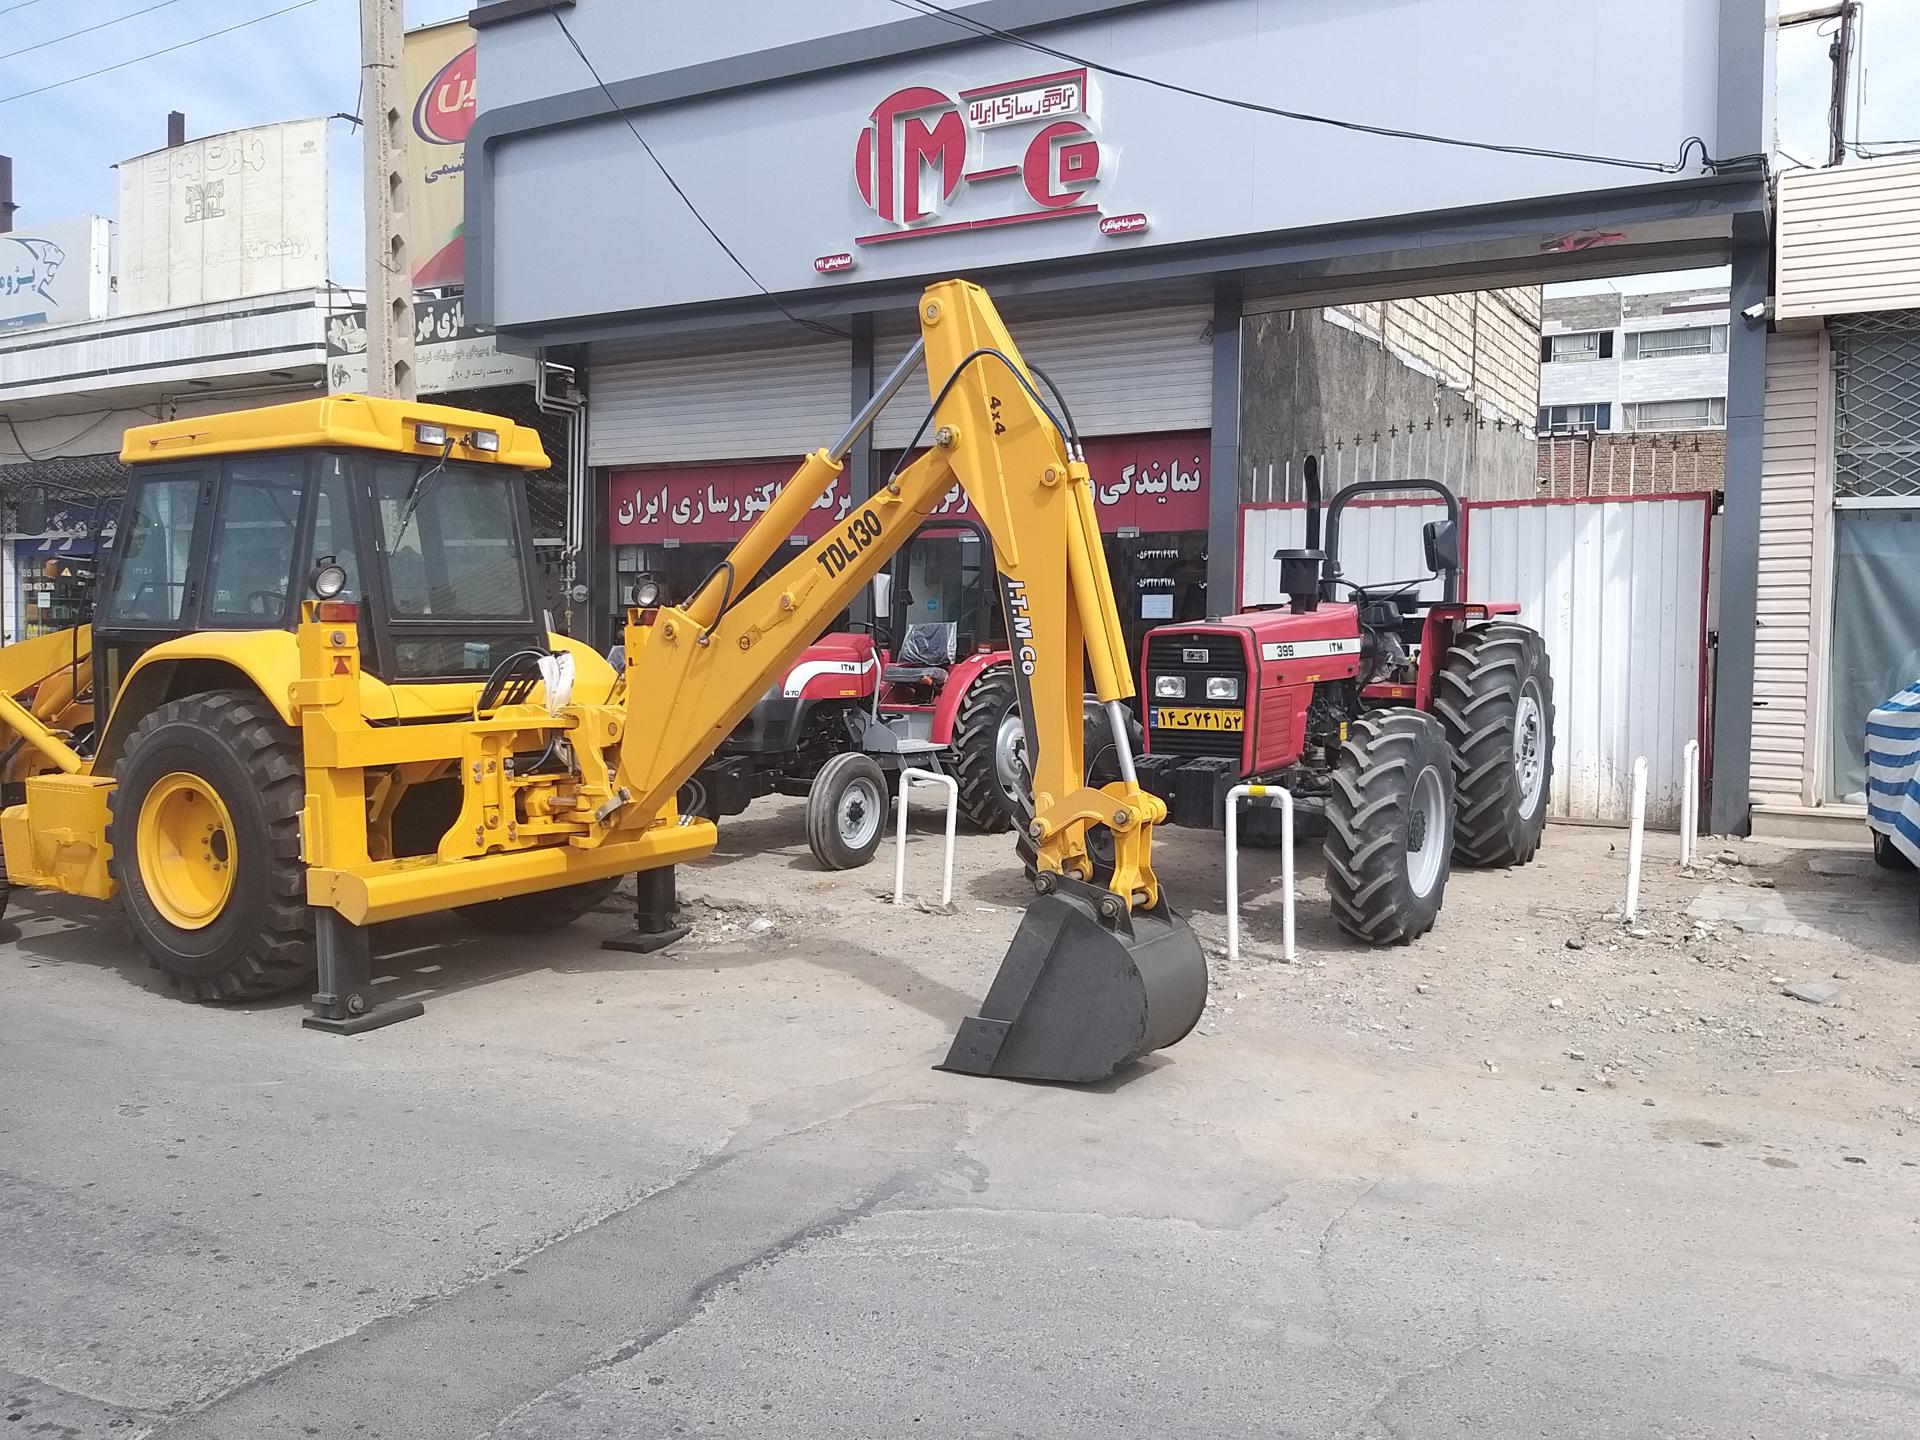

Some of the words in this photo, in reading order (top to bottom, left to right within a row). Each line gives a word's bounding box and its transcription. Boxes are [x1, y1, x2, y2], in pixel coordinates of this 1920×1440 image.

[1099, 456, 1201, 506] نمایندگی
[617, 485, 668, 525] ایران
[816, 509, 882, 580] TDL130
[840, 663, 855, 672] ITM
[1276, 645, 1295, 657] 399
[1328, 642, 1344, 653] ITM
